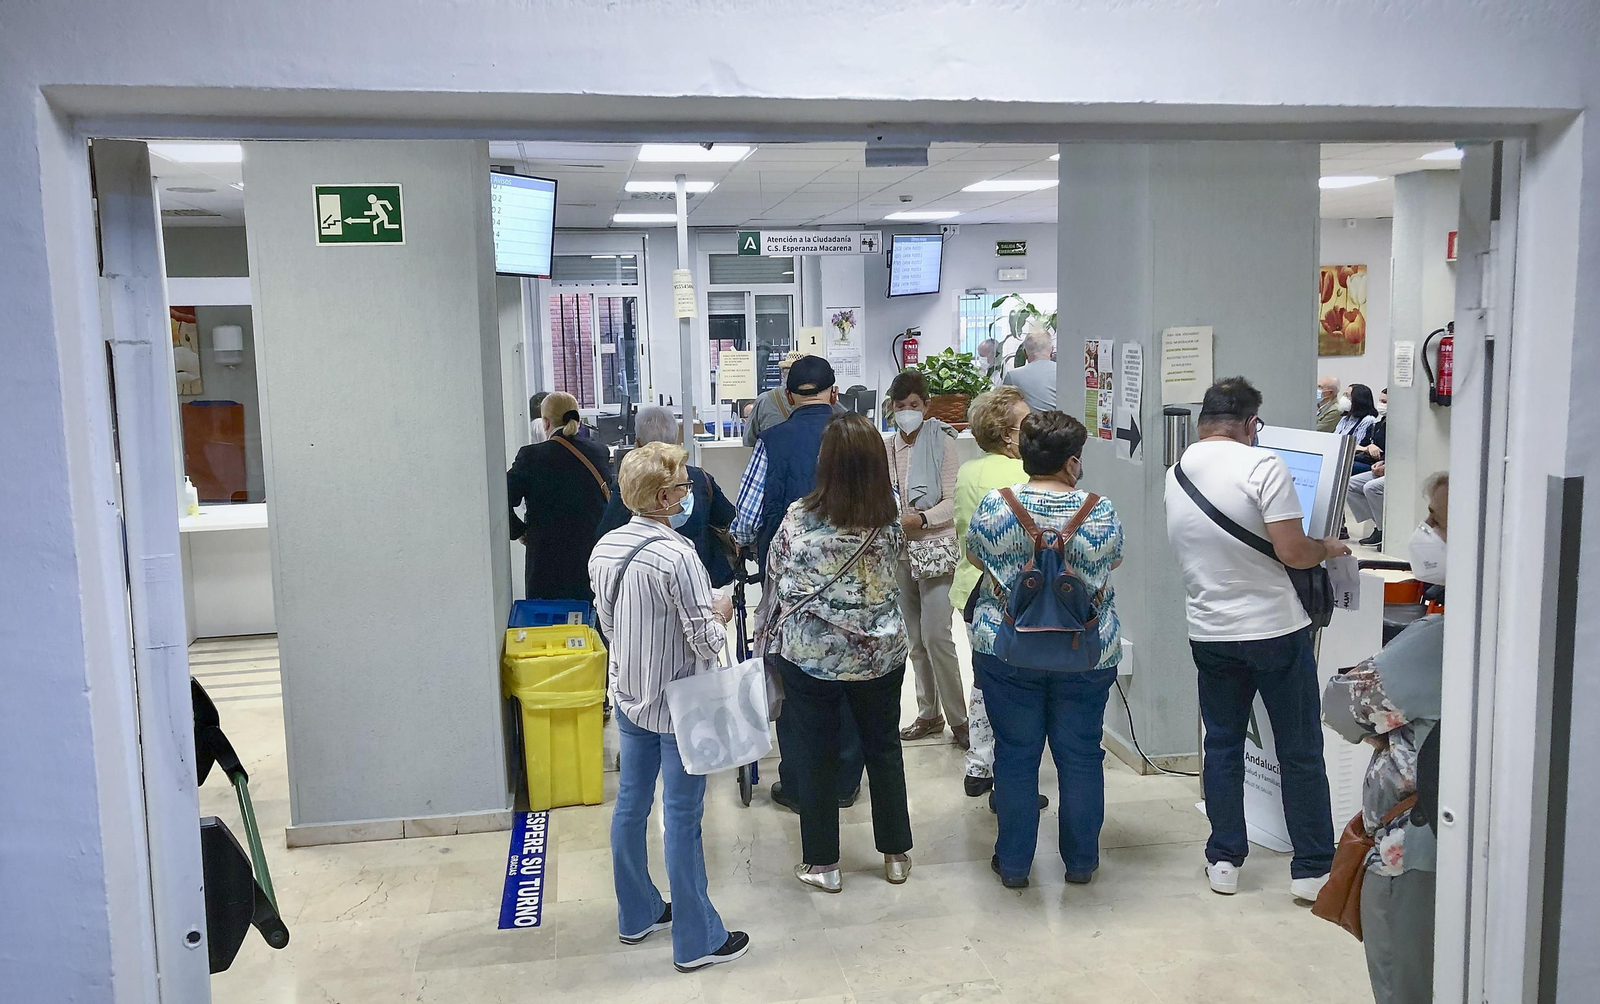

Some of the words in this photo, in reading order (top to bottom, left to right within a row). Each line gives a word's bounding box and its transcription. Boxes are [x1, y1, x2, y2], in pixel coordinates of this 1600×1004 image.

[767, 235, 798, 243] Atención
[804, 235, 812, 243] la
[812, 234, 852, 243] Ciudadanía
[782, 245, 818, 253] Esperanza
[810, 336, 817, 345] 1
[1245, 751, 1282, 775] Andalucí
[522, 811, 546, 855] ESPERE
[508, 854, 519, 876] GRACIAS
[520, 857, 543, 875] SU
[513, 877, 541, 927] TURNO
